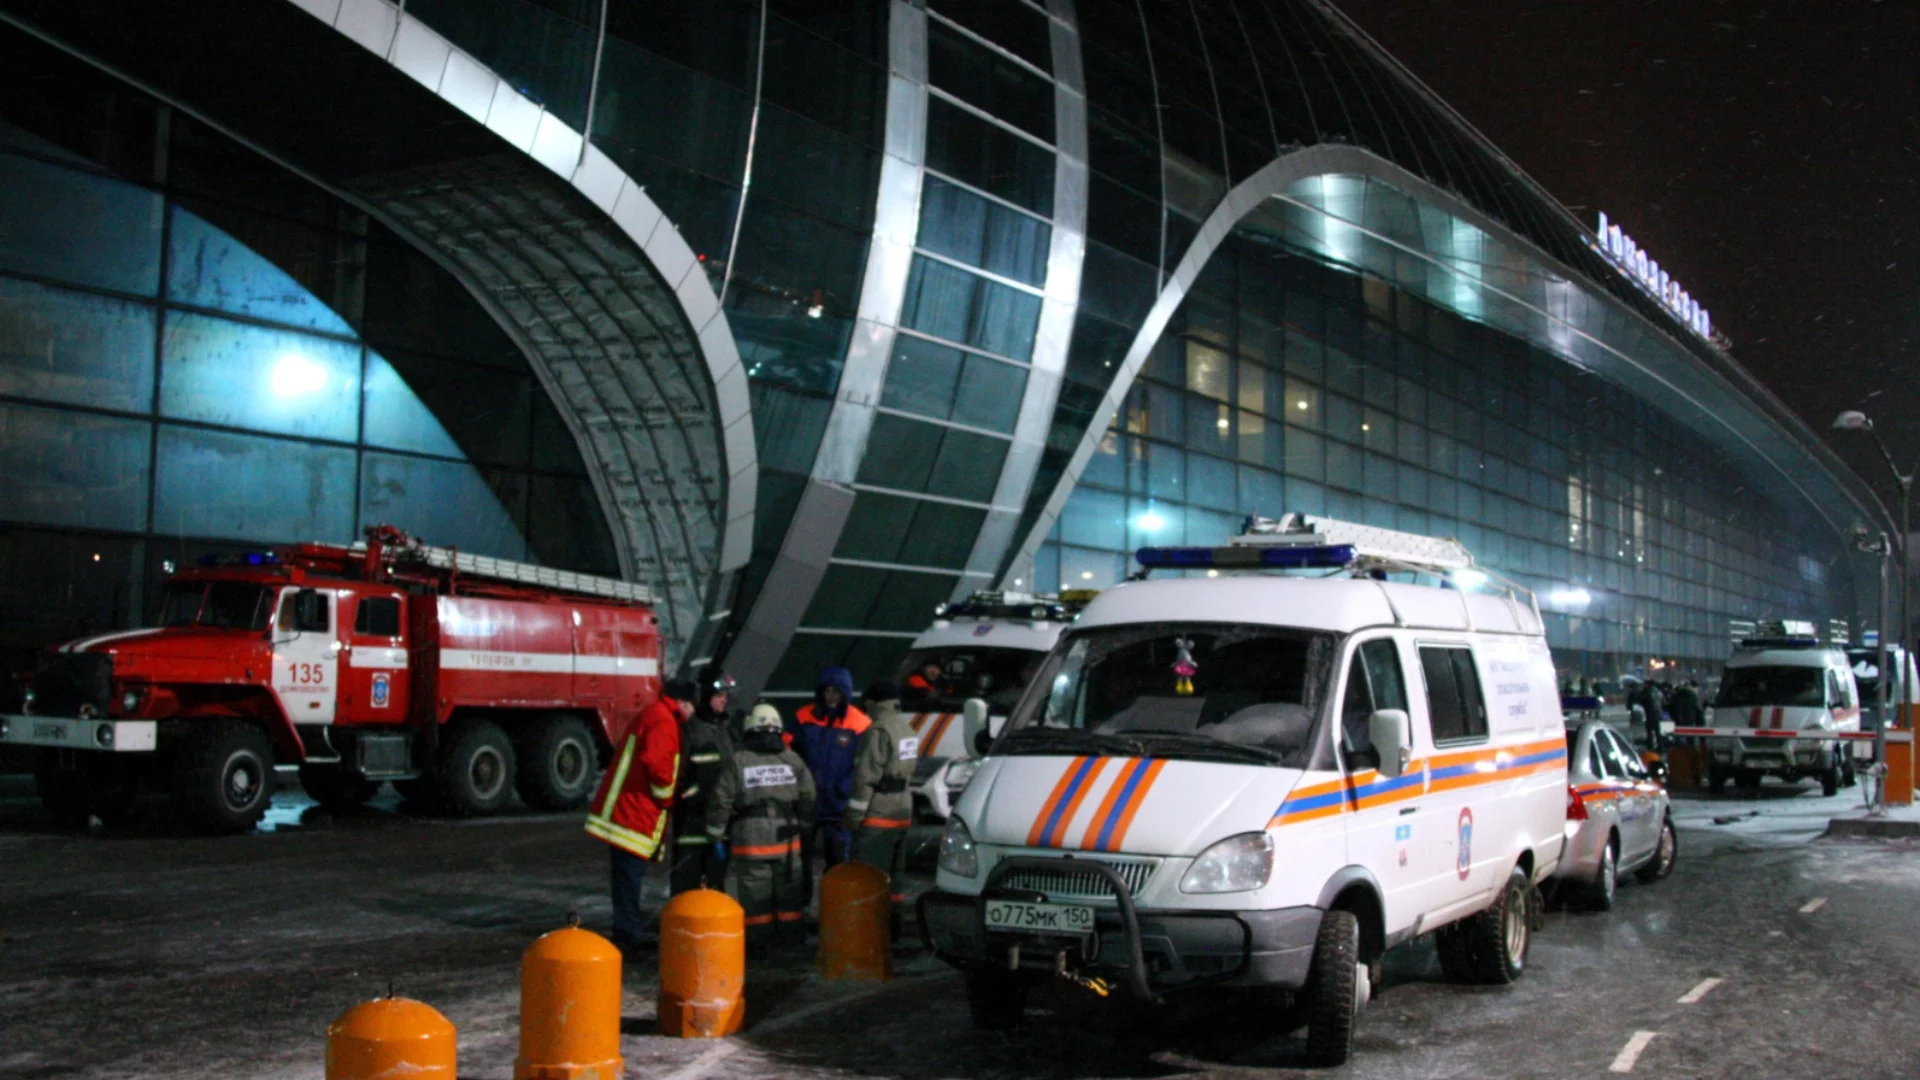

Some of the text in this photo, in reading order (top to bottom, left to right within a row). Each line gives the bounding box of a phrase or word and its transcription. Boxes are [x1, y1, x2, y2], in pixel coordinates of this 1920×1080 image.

[288, 663, 323, 684] 135
[990, 905, 1090, 927] О775МК 150
